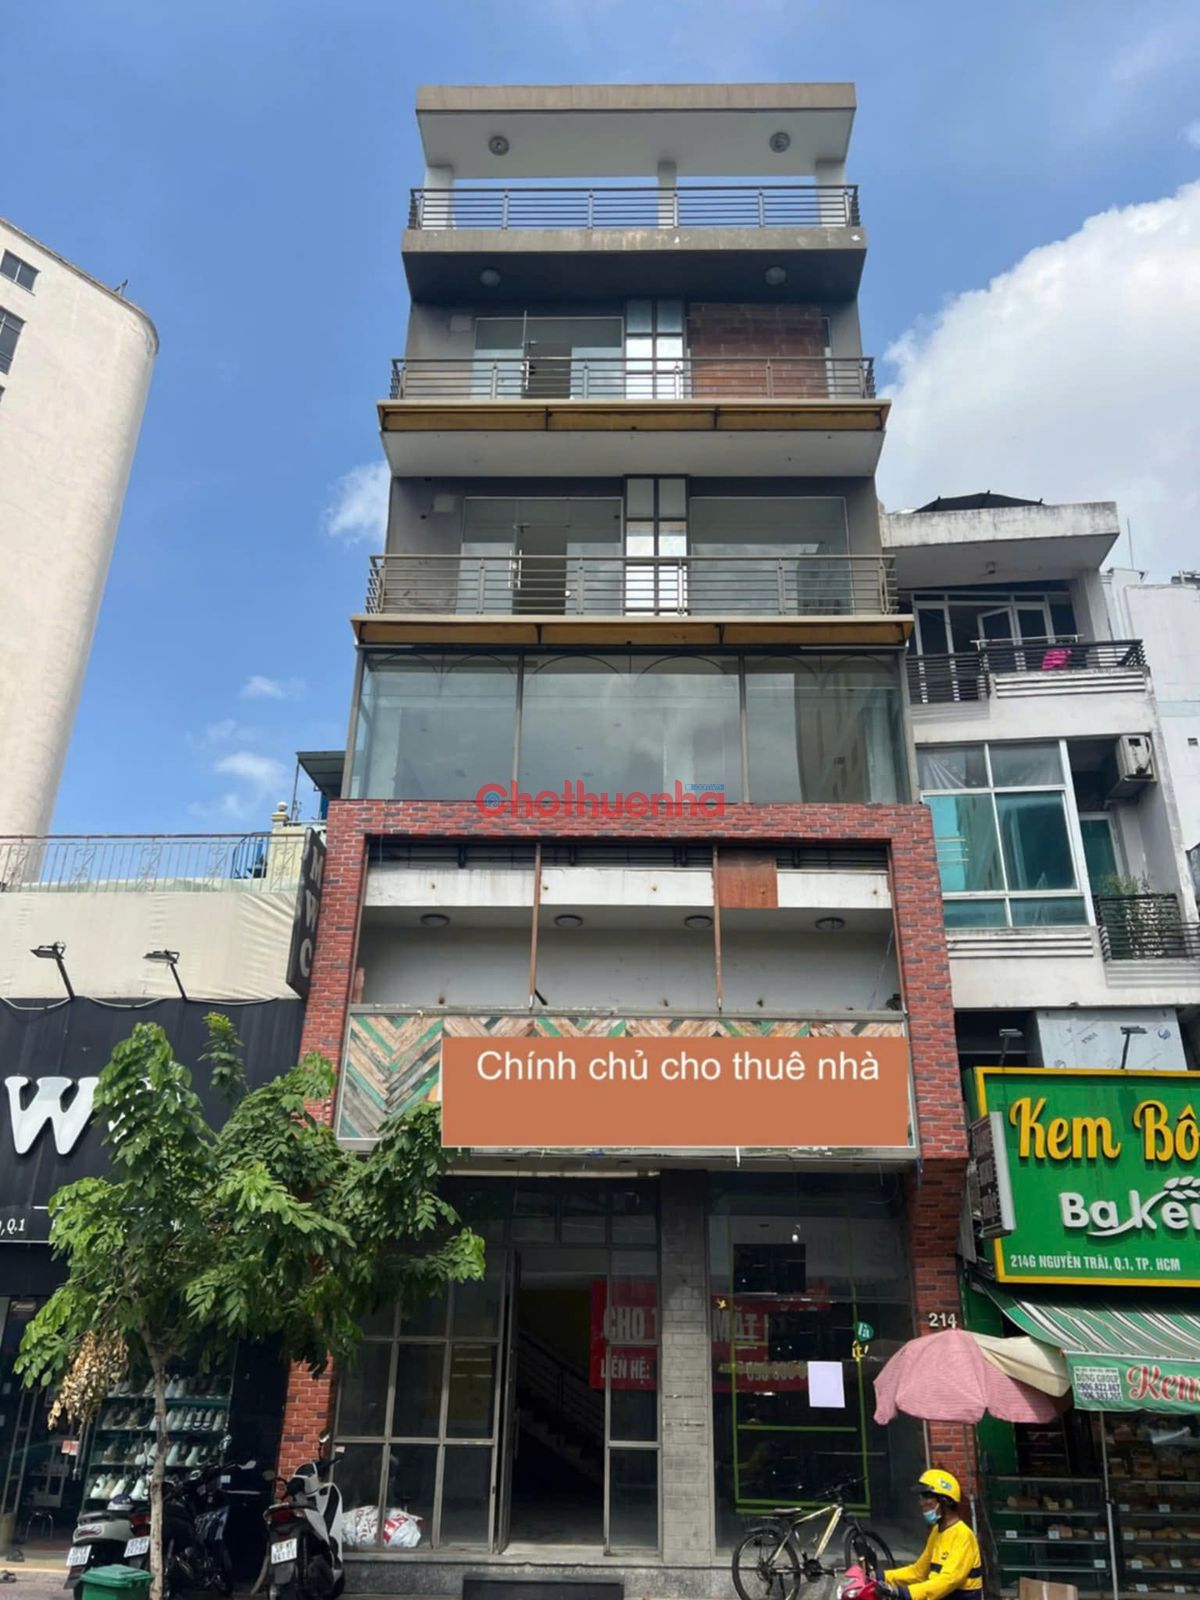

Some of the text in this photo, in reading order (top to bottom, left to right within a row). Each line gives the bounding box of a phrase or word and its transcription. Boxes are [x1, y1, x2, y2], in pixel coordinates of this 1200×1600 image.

[1010, 1097, 1200, 1162] Kem Bô
[1039, 1251, 1081, 1269] NGUYỄN
[1156, 1258, 1181, 1272] HCM
[603, 1307, 645, 1340] CHO
[928, 1312, 957, 1329] 214
